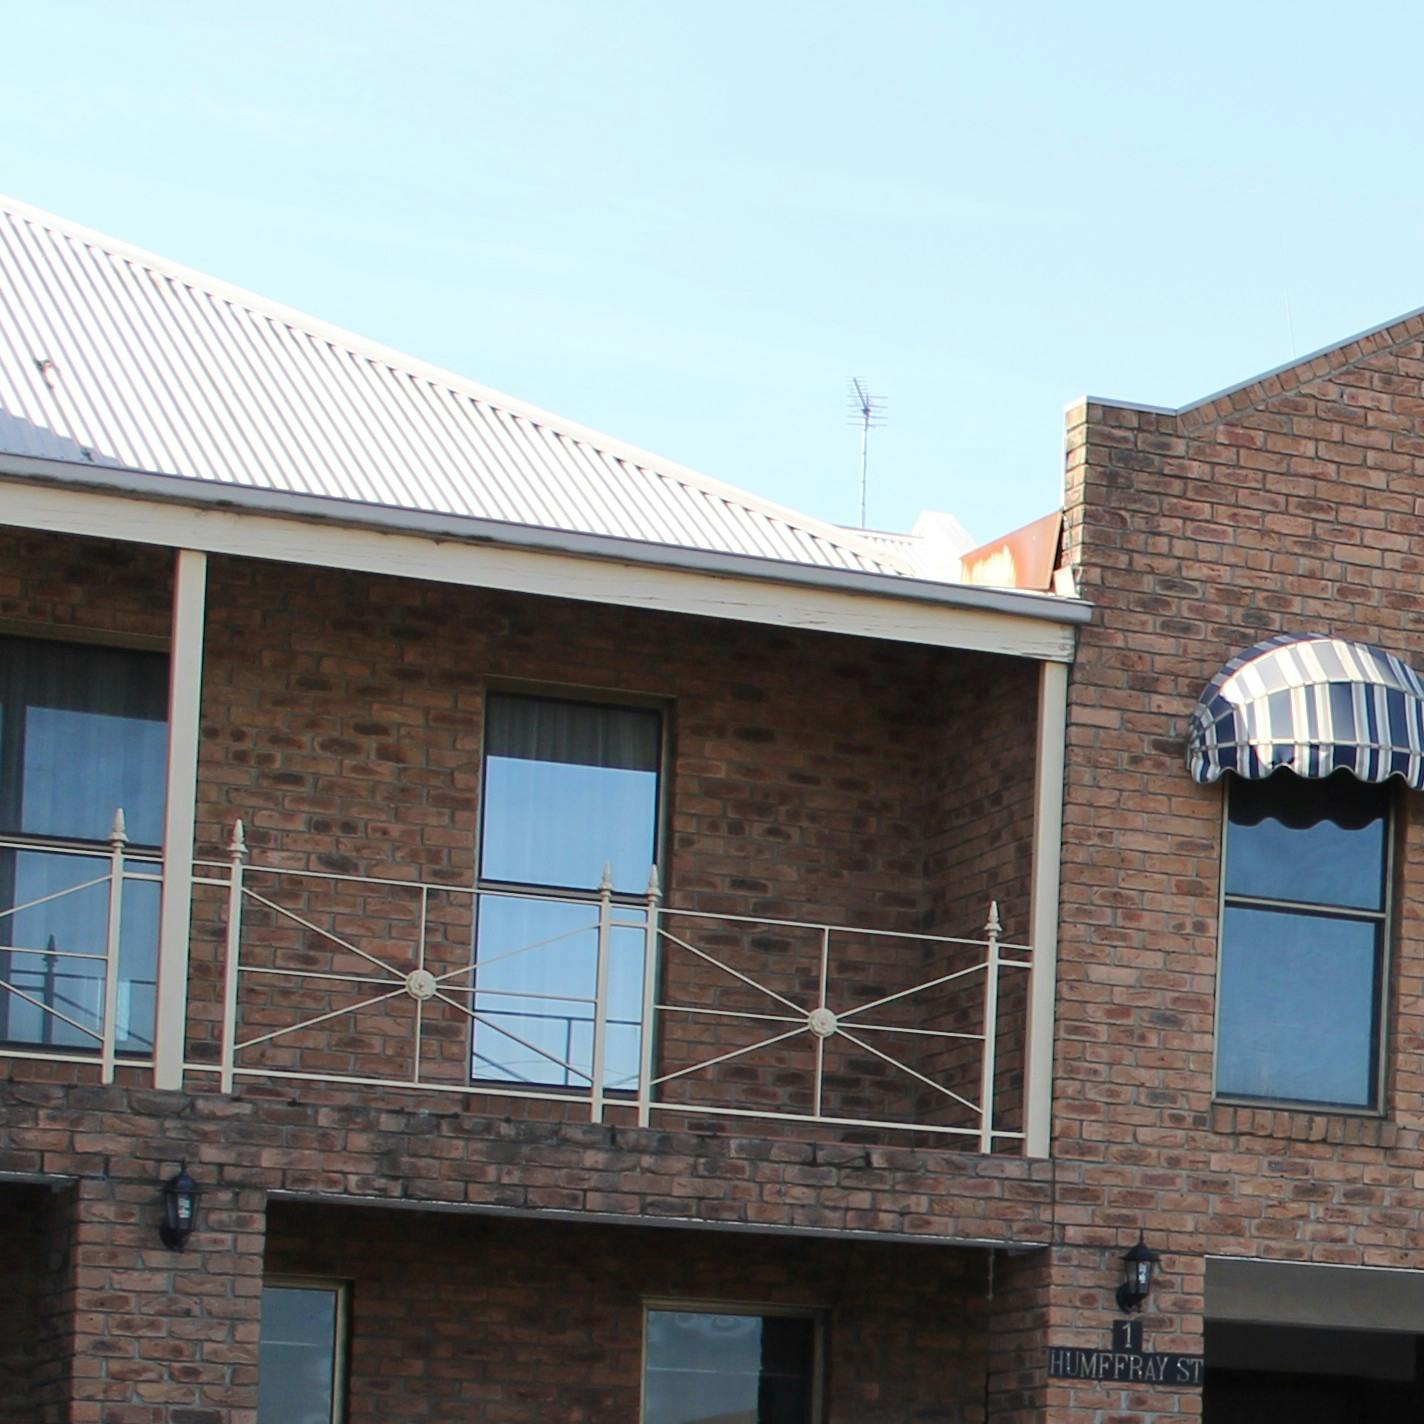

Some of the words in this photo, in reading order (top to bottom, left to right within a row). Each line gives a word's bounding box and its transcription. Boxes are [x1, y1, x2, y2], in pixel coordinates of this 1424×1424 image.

[1121, 1322, 1133, 1348] 1
[1050, 1349, 1169, 1382] HUMFFRAY
[1176, 1357, 1204, 1384] ST
